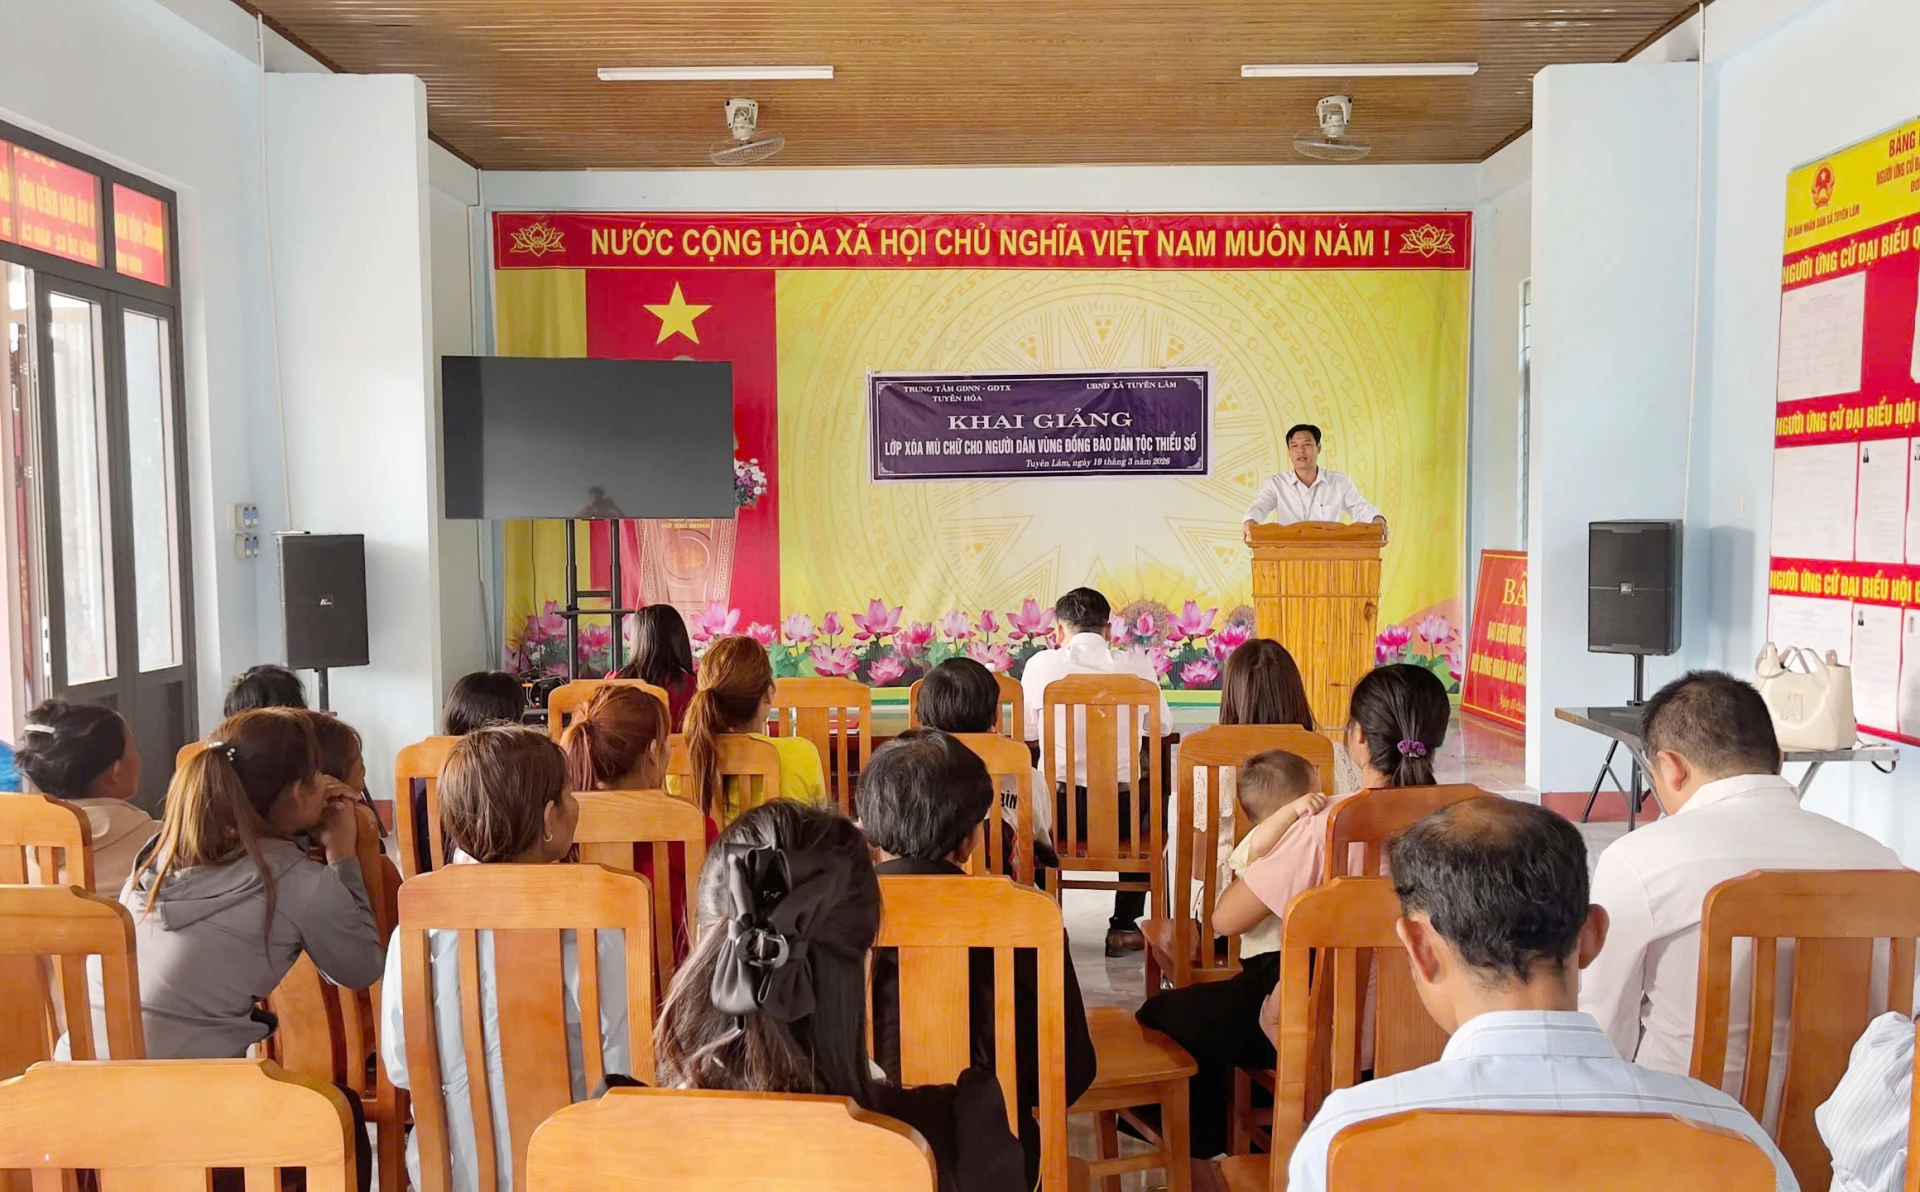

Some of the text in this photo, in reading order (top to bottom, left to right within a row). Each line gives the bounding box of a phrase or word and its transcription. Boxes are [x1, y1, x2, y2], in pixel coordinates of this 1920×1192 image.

[1889, 130, 1915, 157] BẢNG
[591, 222, 674, 255] NƯỚC
[682, 225, 761, 262] CỘNG
[771, 222, 828, 255] HÒA
[836, 222, 871, 255] XÃ
[881, 225, 926, 261] HỘI
[935, 223, 991, 256] CHỦ
[1000, 222, 1082, 256] NGHĨA
[1091, 224, 1149, 262] VIỆT
[1157, 229, 1216, 256] NAM
[1225, 222, 1305, 256] MUÔN
[1315, 222, 1374, 256] NĂM
[1782, 255, 1812, 285] NGƯỜI
[1815, 251, 1838, 276] ỨNG
[1840, 239, 1857, 269] CỬ
[1858, 238, 1879, 265] ĐẠI
[1881, 222, 1909, 258] BIỂU
[933, 393, 982, 402] TUYÊN HÓA
[935, 384, 954, 392] TÂM
[987, 384, 1012, 392] GDTX
[1112, 381, 1124, 389] XÃ
[1126, 380, 1156, 389] TUYÊN
[1158, 380, 1177, 388] LÂM
[948, 407, 1133, 430] KHAI GIẢNG
[1776, 410, 1804, 436] NGƯỜI
[1806, 409, 1827, 433] ỨNG
[1829, 403, 1845, 431] CỬ
[1846, 407, 1865, 433] ĐẠI
[1867, 396, 1893, 428] BIỂU
[1895, 397, 1915, 428] HỘI
[885, 438, 902, 456] LỚP
[904, 438, 923, 455] XÓA
[926, 438, 941, 455] MÙ
[943, 437, 963, 455] CHỮ
[964, 439, 983, 455] CHO
[985, 436, 1014, 454] NGƯỜI
[1016, 436, 1035, 454] DÂN
[1038, 436, 1062, 453] VÙNG
[1093, 434, 1112, 452] BÀO
[1114, 434, 1133, 452] DÂN
[1135, 434, 1153, 454] TỘC
[1155, 430, 1181, 452] THIỂU
[1183, 431, 1197, 452] SỐ
[1026, 459, 1050, 469] Tuyên
[1072, 458, 1091, 469] ngày
[1093, 458, 1103, 466] 19
[1104, 457, 1127, 467] tháng
[1152, 457, 1171, 465] 2026
[1770, 566, 1798, 592] NGƯỜI
[1801, 568, 1822, 594] ỨNG
[1824, 568, 1840, 595] CỬ
[1841, 575, 1859, 601] ĐẠI
[1862, 569, 1889, 599] BIỂU
[1891, 575, 1912, 606] HỘI
